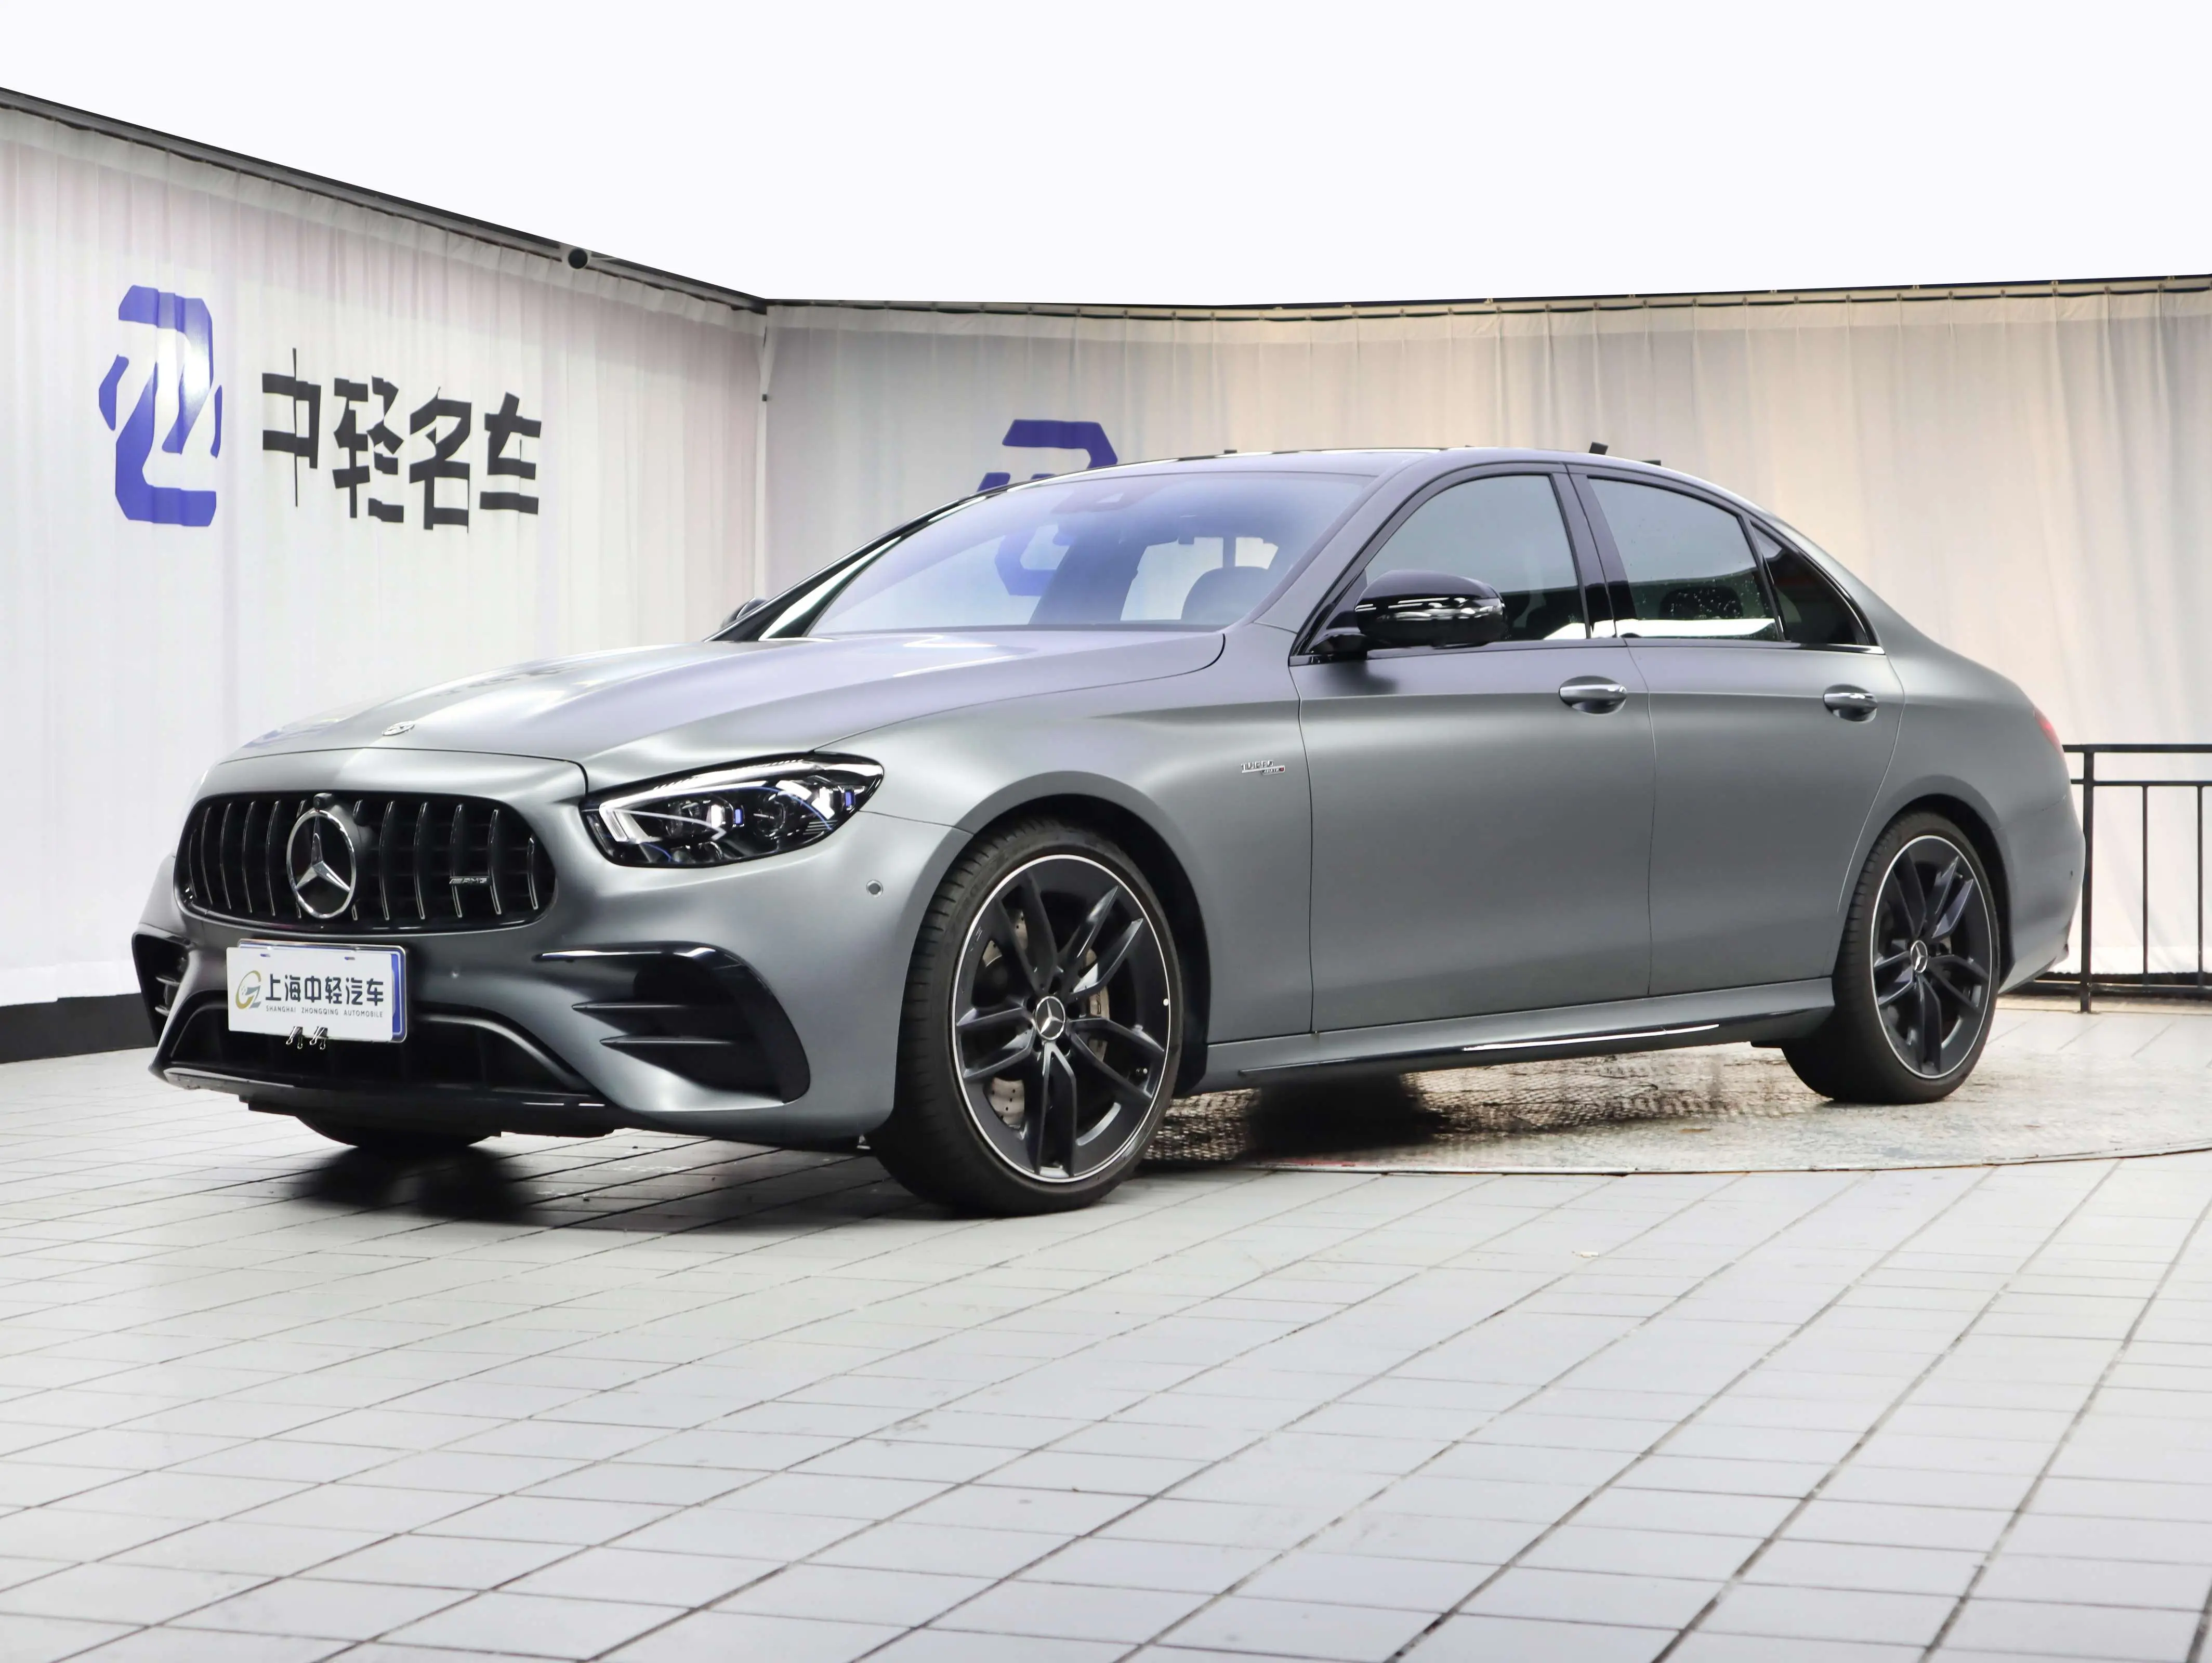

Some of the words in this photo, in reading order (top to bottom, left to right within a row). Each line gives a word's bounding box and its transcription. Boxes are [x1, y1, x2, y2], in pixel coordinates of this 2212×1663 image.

[262, 347, 542, 533] 中轻名车
[265, 973, 384, 1006] 上海中轻汽车
[301, 1007, 339, 1015] ZHONGQING
[344, 1010, 383, 1018] AUTOMOBILE
